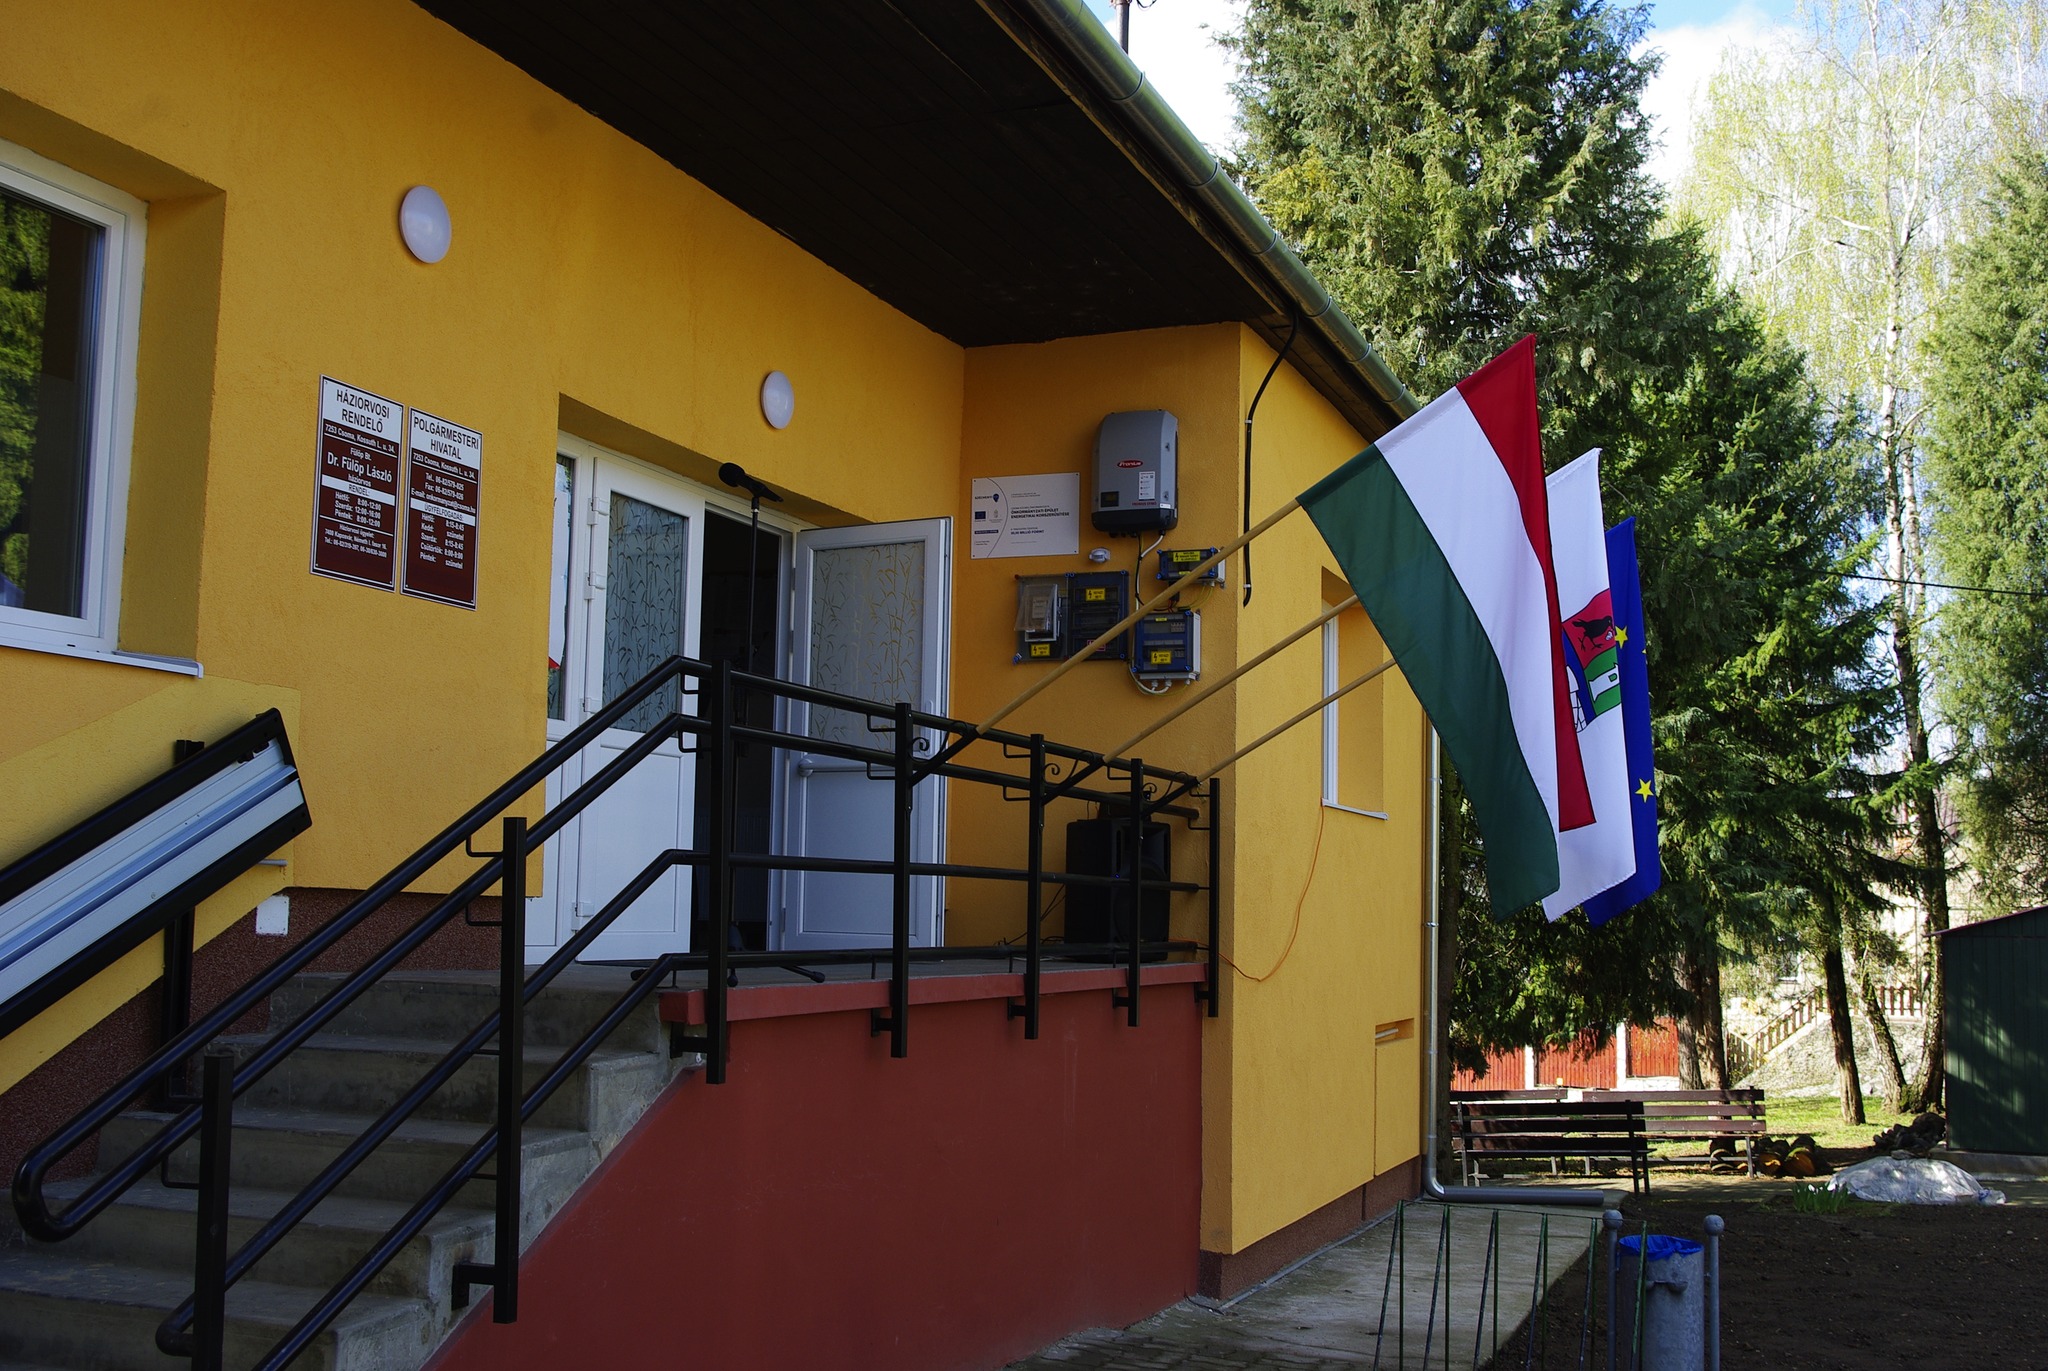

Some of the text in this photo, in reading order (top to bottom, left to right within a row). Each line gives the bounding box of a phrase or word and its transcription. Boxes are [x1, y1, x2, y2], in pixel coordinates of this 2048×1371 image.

[336, 389, 390, 419] HÁZIORVOSI
[342, 408, 384, 433] RENDELŐ
[413, 416, 479, 450] POLGÁRMESTERI
[356, 433, 376, 444] Kossuth
[430, 438, 462, 460] HIVATAL
[327, 451, 340, 467] Dr.
[366, 464, 392, 483] László
